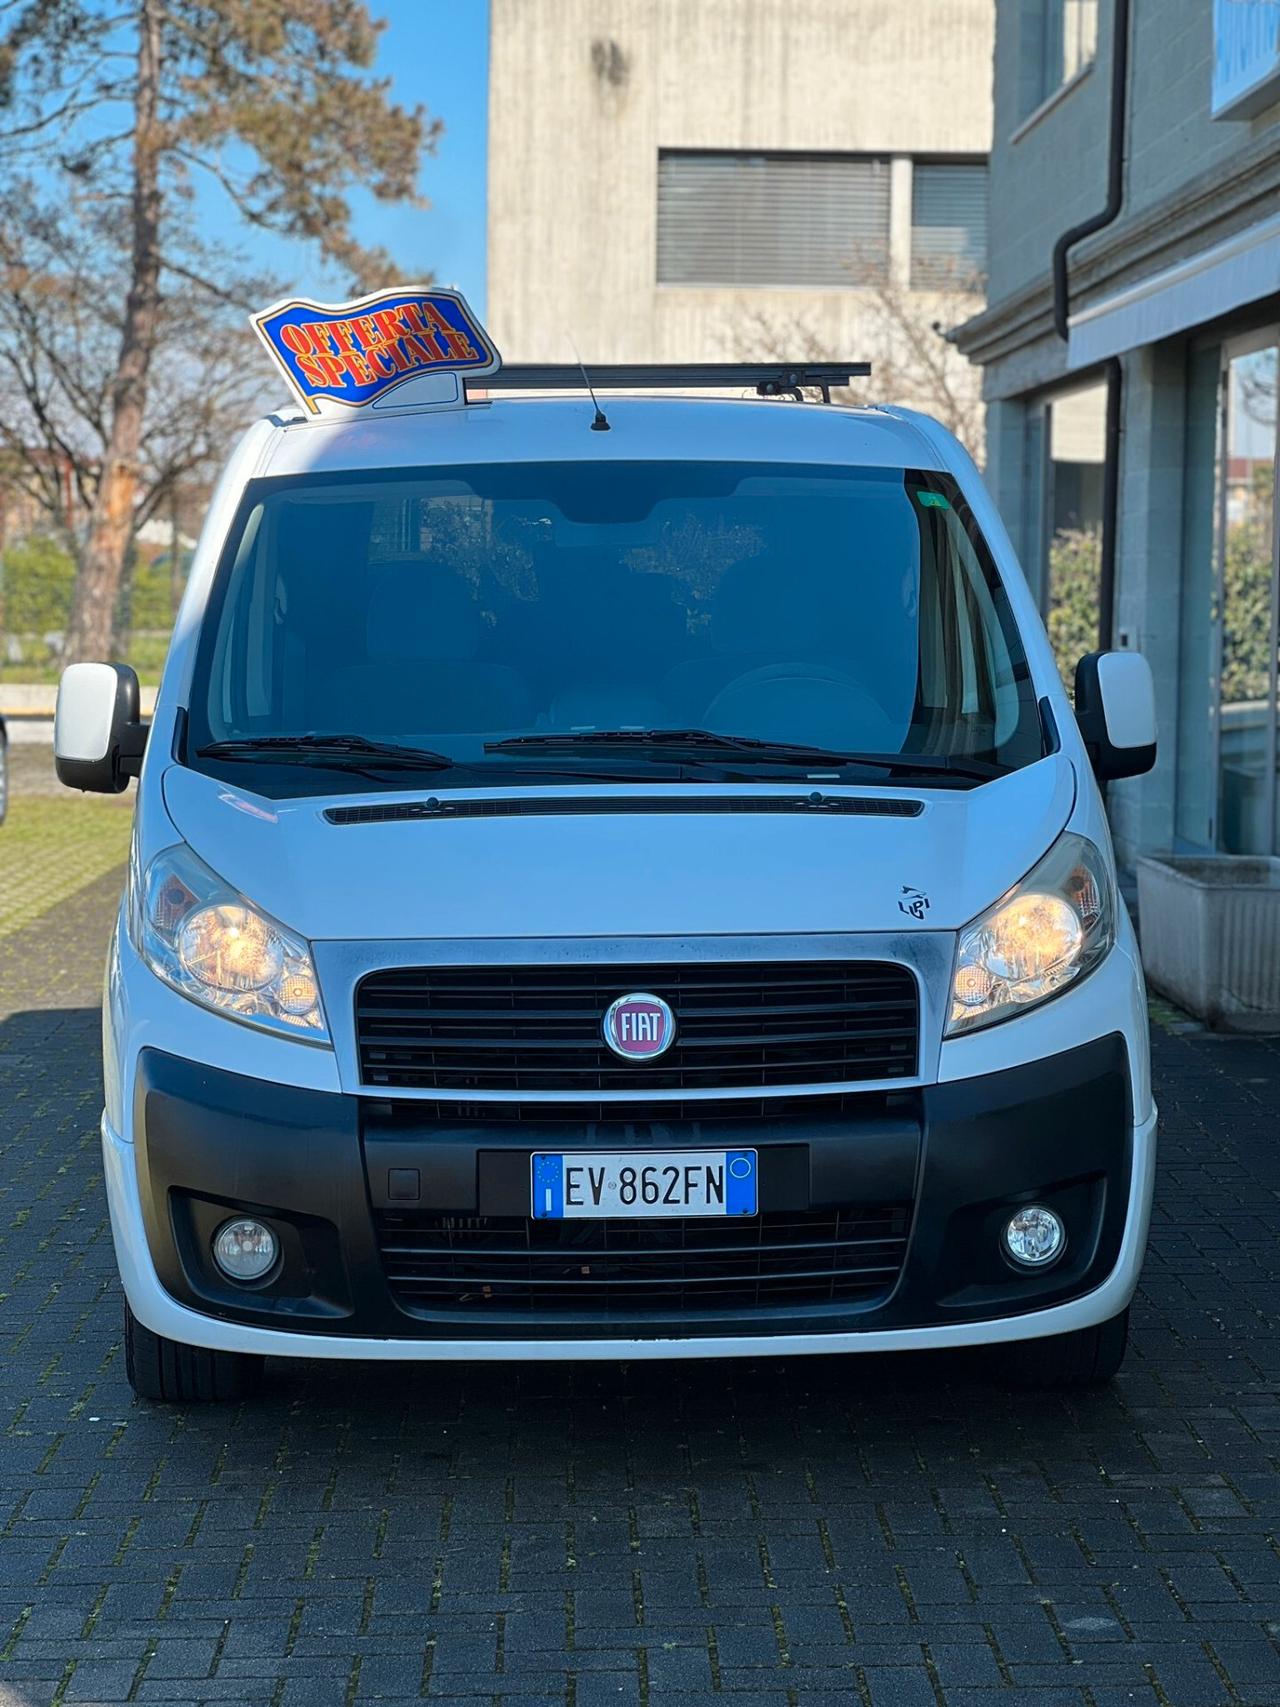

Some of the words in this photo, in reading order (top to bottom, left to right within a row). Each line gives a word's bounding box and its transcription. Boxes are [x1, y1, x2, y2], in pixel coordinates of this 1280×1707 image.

[279, 302, 457, 355] OFFERTA
[295, 331, 480, 389] SPECIALE
[621, 1012, 661, 1041] FIAT
[565, 1166, 606, 1206] EV
[618, 1165, 724, 1206] 862FN
